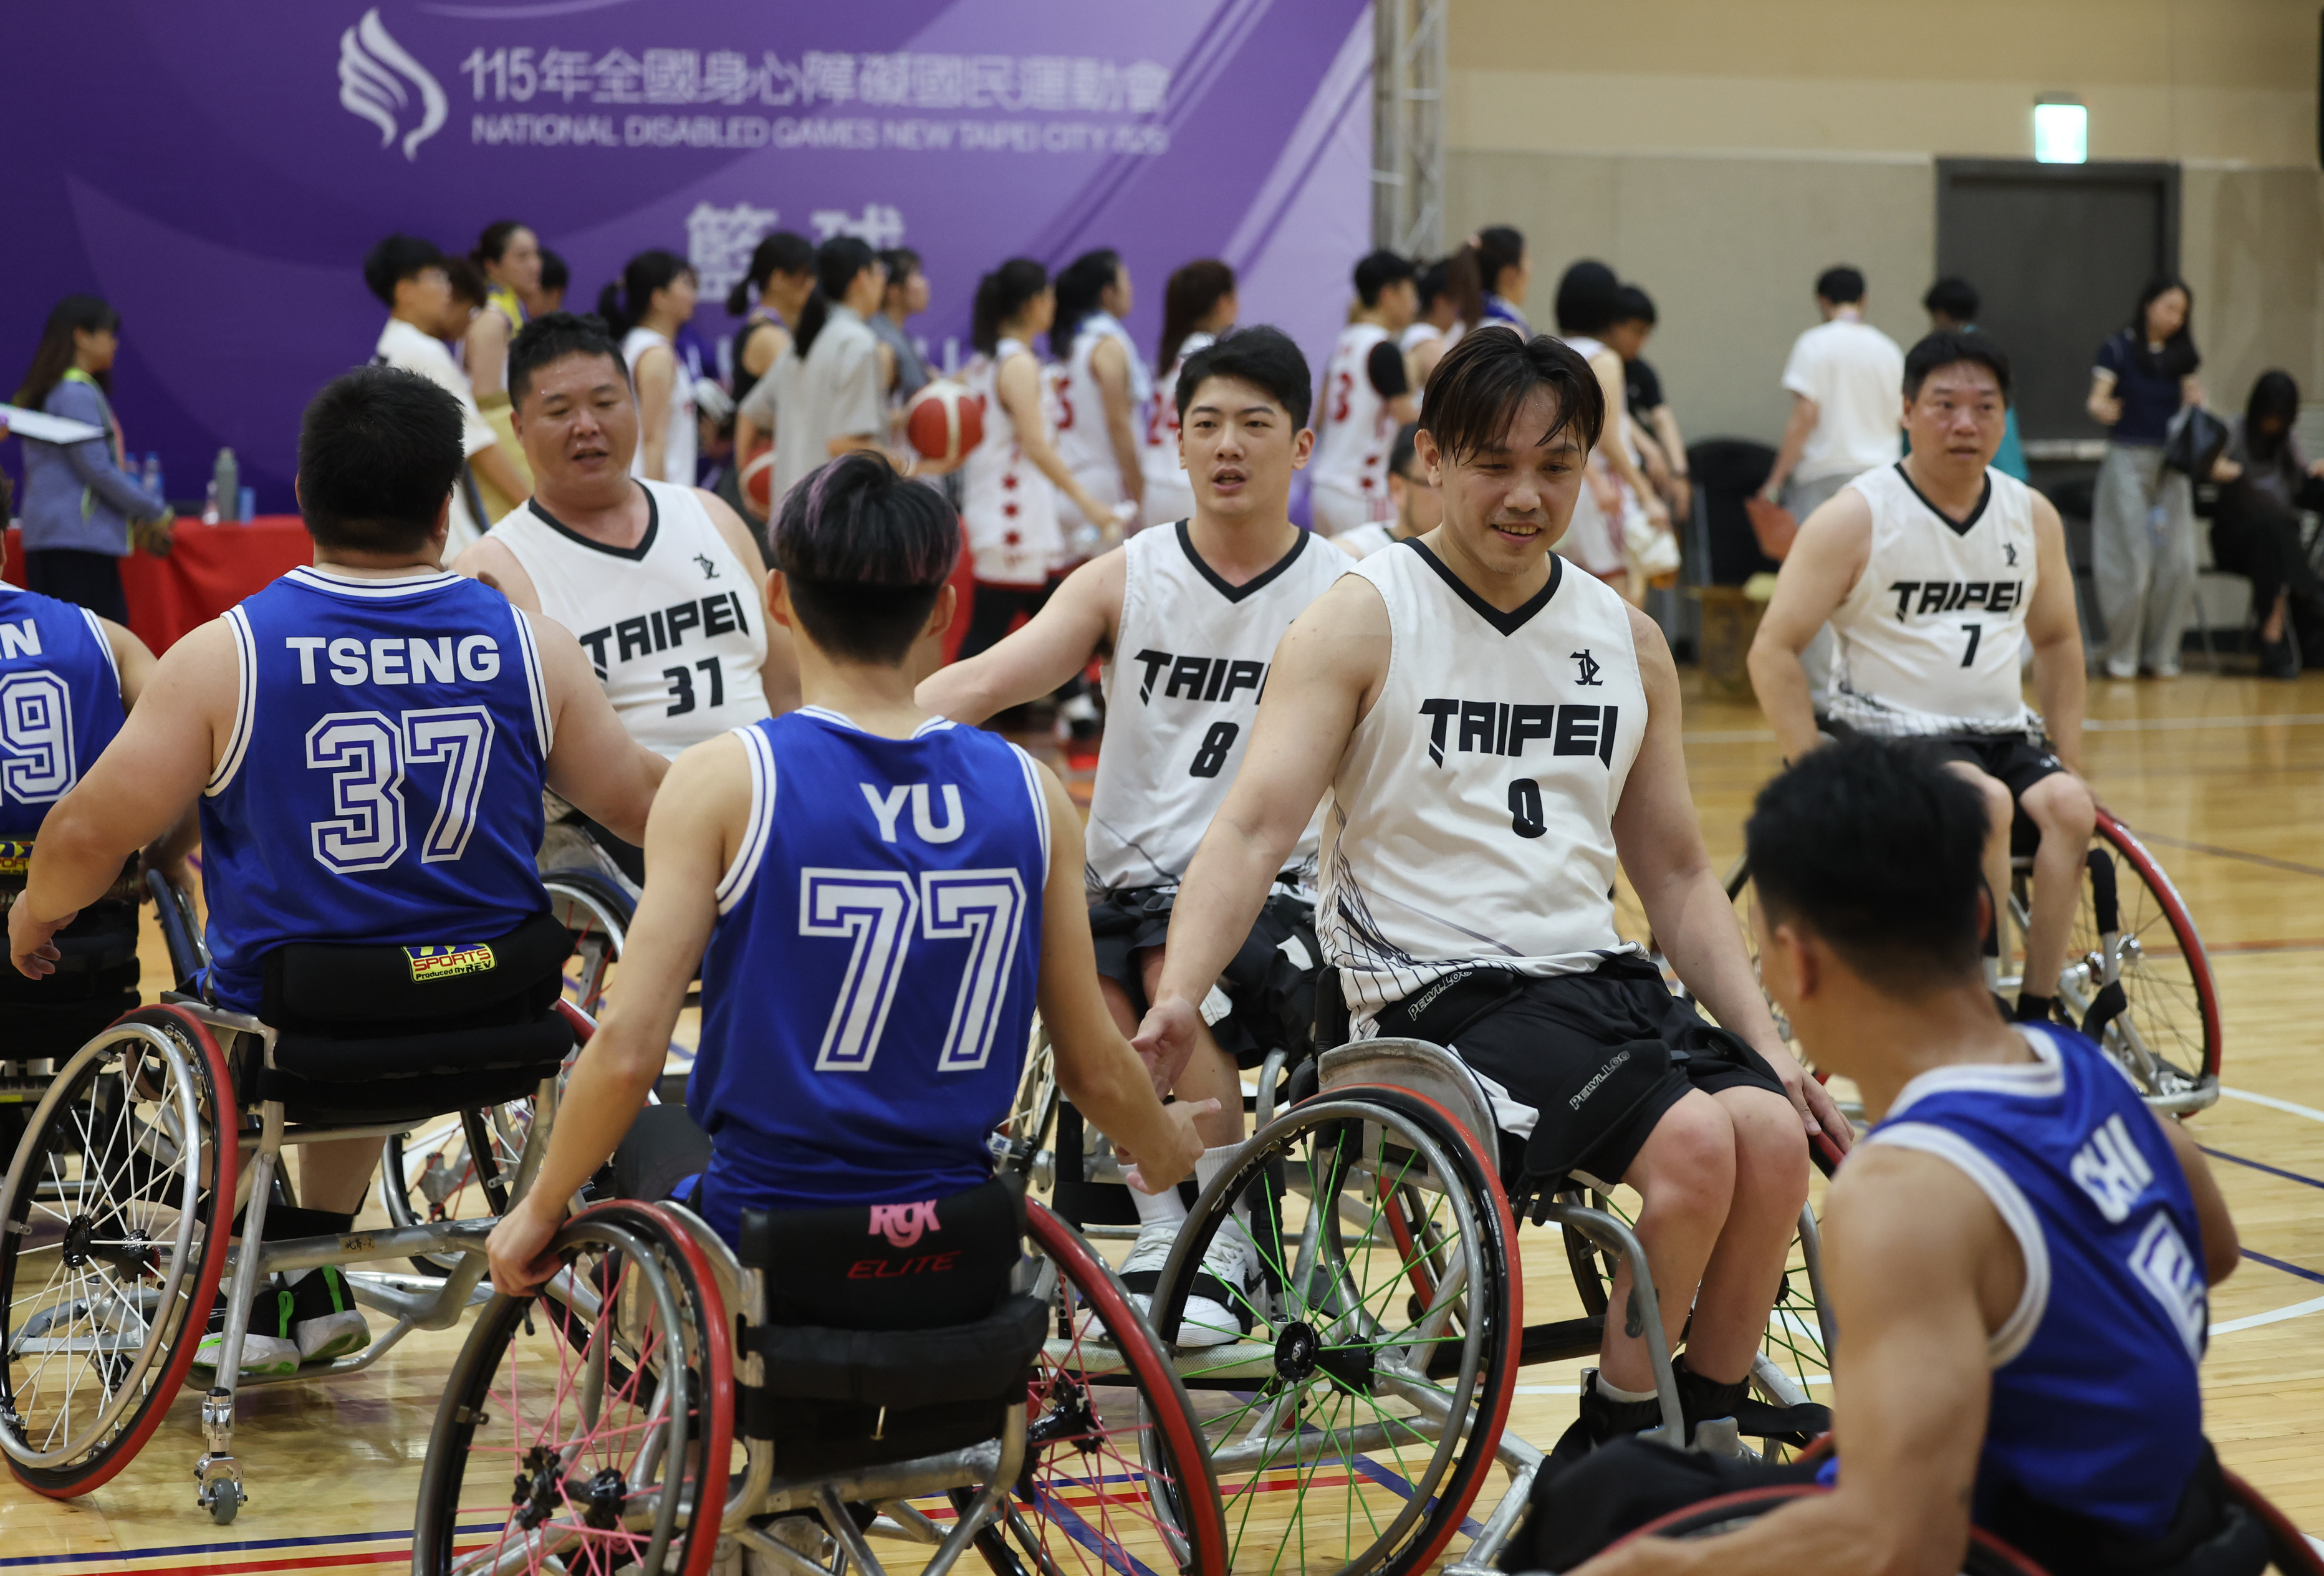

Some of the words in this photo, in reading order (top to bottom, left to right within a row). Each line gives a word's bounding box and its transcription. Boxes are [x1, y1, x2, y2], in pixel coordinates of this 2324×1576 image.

[471, 113, 620, 147] NATIONAL
[623, 114, 771, 148] DISABLED
[771, 116, 876, 150] GAMES
[882, 119, 954, 151] NEW
[959, 120, 1040, 153] TAIPEI
[1042, 121, 1110, 153] CITY
[1888, 580, 2022, 622] TAIPEI
[0, 618, 42, 660] N
[286, 635, 500, 685] TSENG
[579, 591, 749, 682] TAIPEI
[1961, 624, 1981, 668] 7
[1133, 649, 1270, 706] TAIP
[0, 670, 77, 805] 9
[1189, 721, 1239, 778] 8
[1418, 698, 1618, 771] TAIPEI
[305, 705, 495, 874] 37
[859, 782, 966, 843] YU
[1508, 778, 1547, 838] 0
[413, 949, 491, 971] SPORTS
[416, 969, 453, 979] Produced
[799, 867, 1027, 1072] 77
[847, 1251, 961, 1279] ELITE
